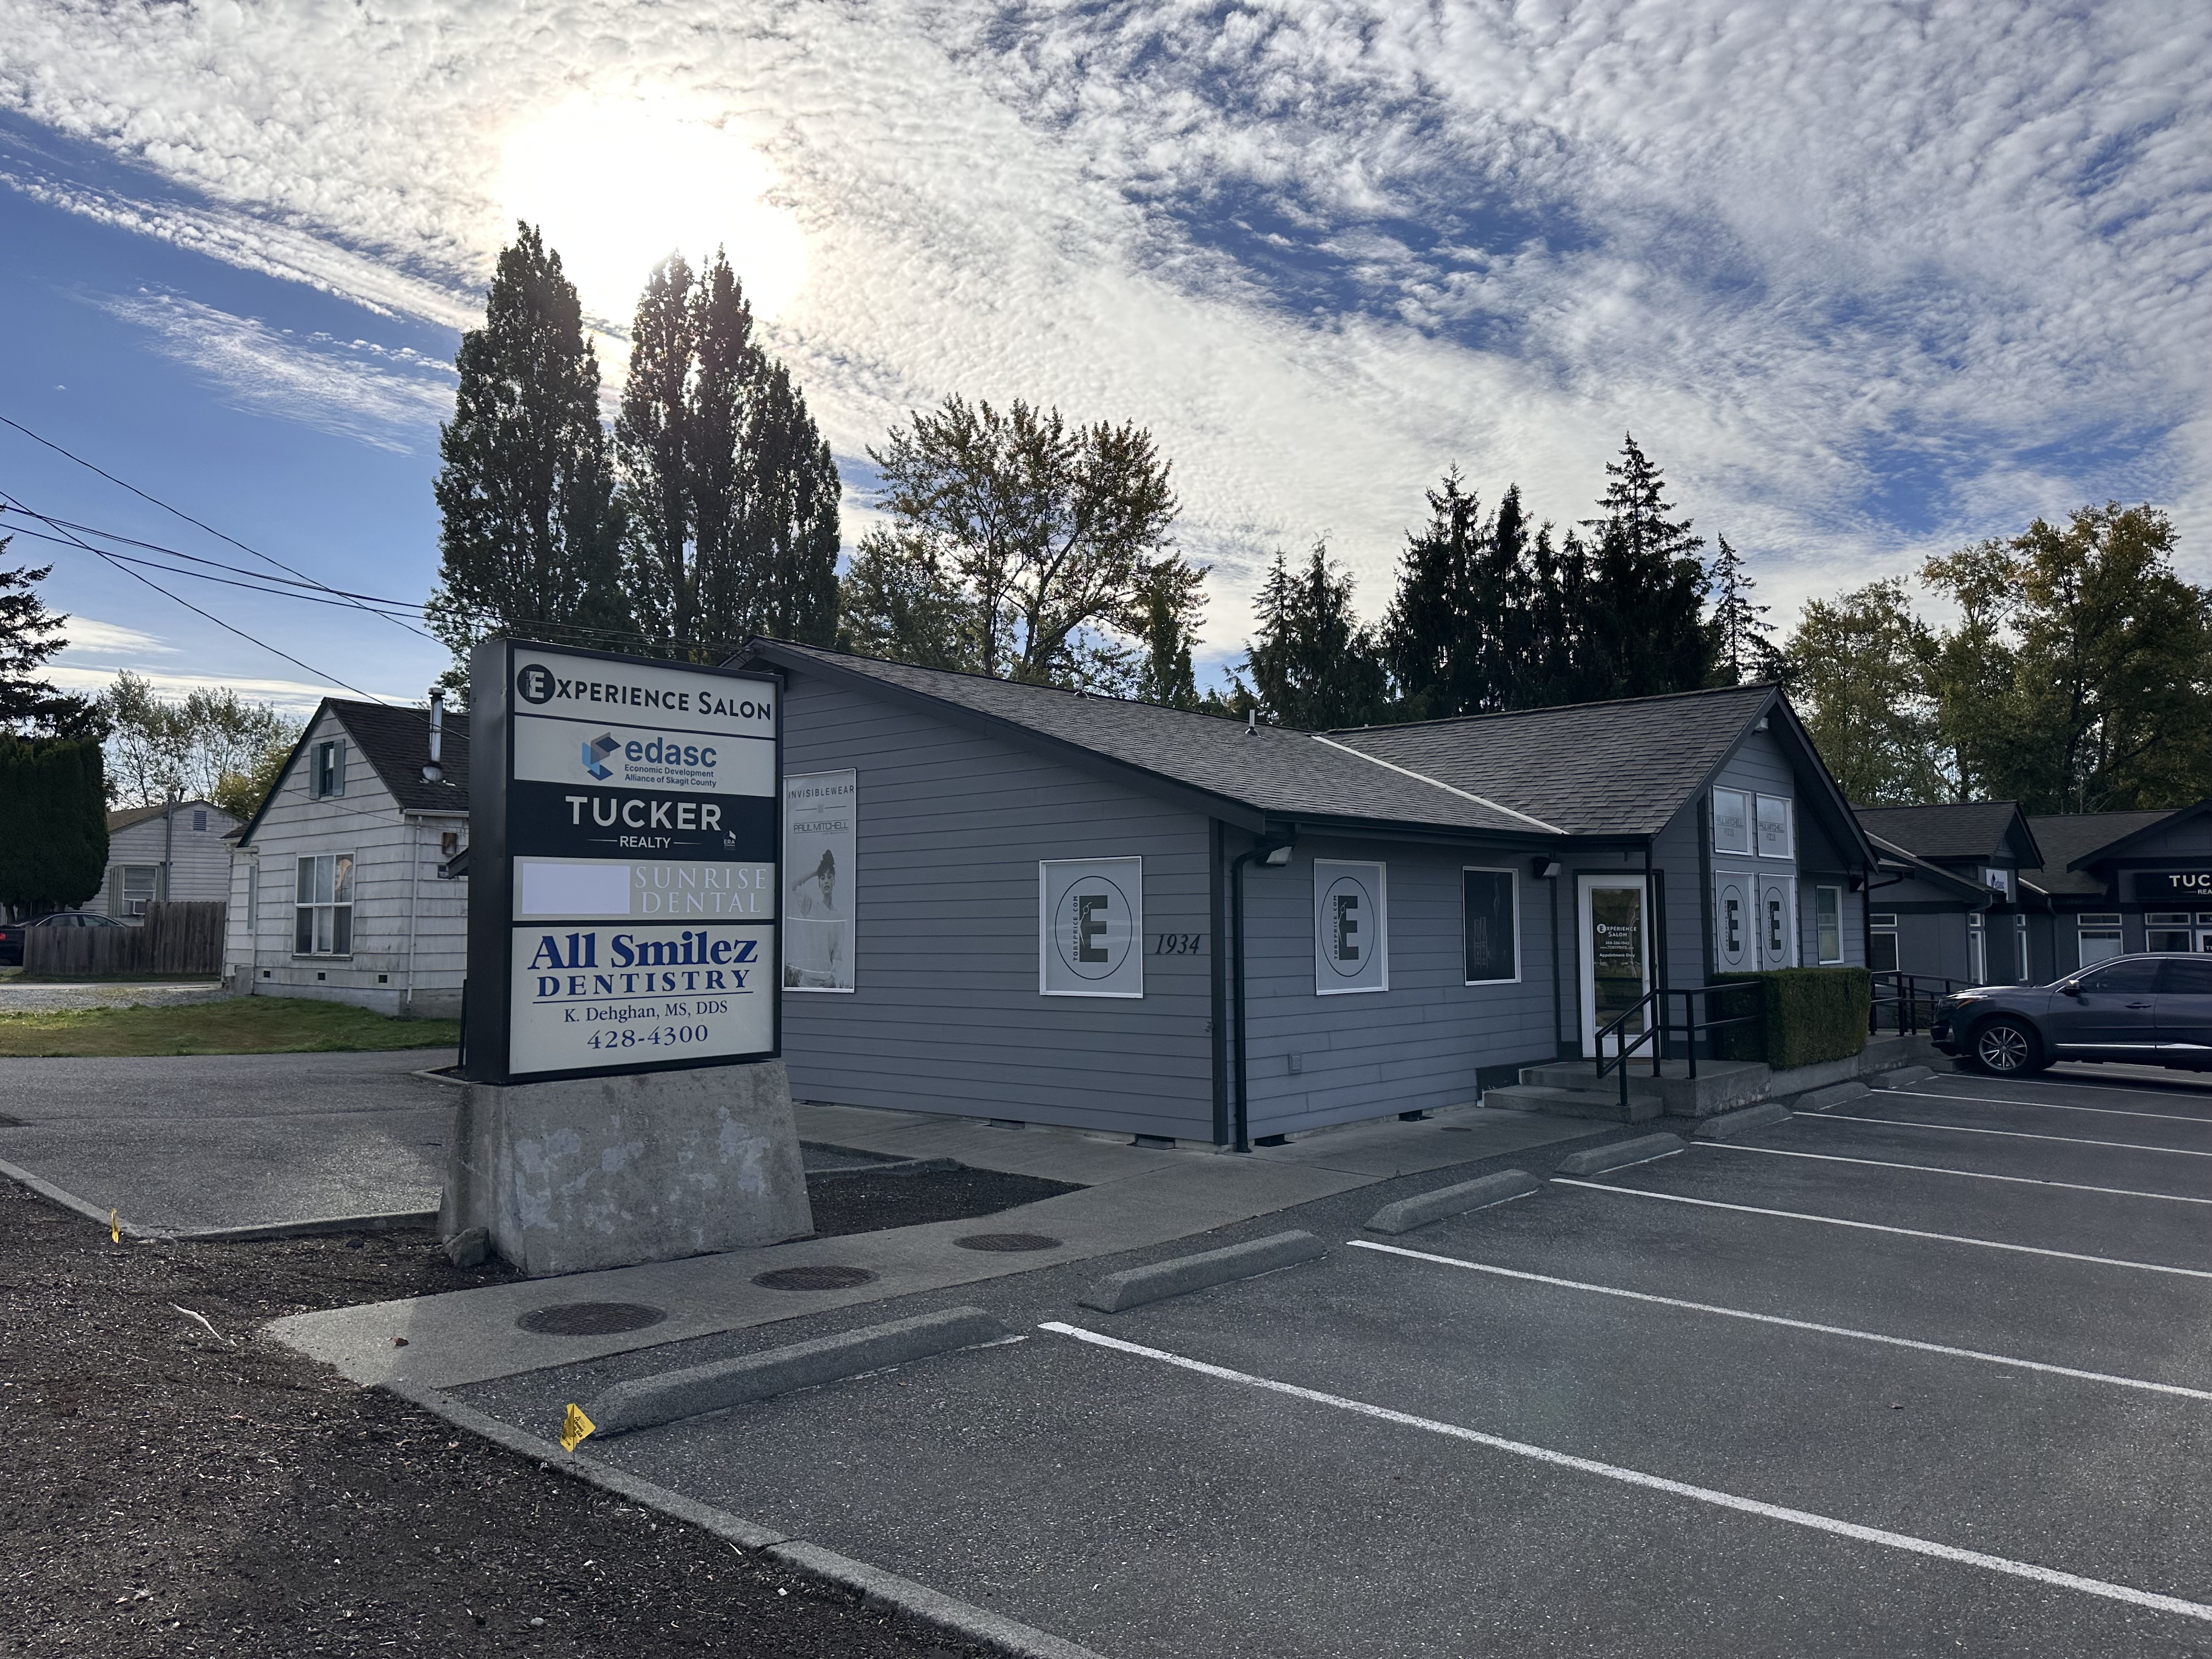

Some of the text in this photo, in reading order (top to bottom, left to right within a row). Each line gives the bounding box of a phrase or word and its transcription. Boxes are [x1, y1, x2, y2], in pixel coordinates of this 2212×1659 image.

[698, 691, 771, 720] SALON
[624, 737, 717, 768] edasc
[624, 764, 714, 777] Economic Development
[624, 774, 655, 782] Alliance
[666, 776, 689, 786] Skagit
[690, 778, 716, 788] County
[788, 785, 854, 799] INVISIBLEWEAR
[565, 795, 722, 831] TUCKER
[793, 821, 849, 832] PAUL MITCHELL
[619, 835, 672, 849] REALTY
[635, 866, 768, 890] SUNRISE
[2169, 874, 2211, 887] TUC
[641, 891, 761, 913] DENTAL
[1079, 895, 1108, 962] E
[1338, 895, 1359, 960] E
[527, 930, 758, 970] All Smilez
[1155, 934, 1201, 955] 1934
[537, 969, 751, 997] DENTISTRY
[563, 1000, 728, 1024] K. Dehghan, MS, DDS
[587, 1024, 709, 1050] 428-4300
